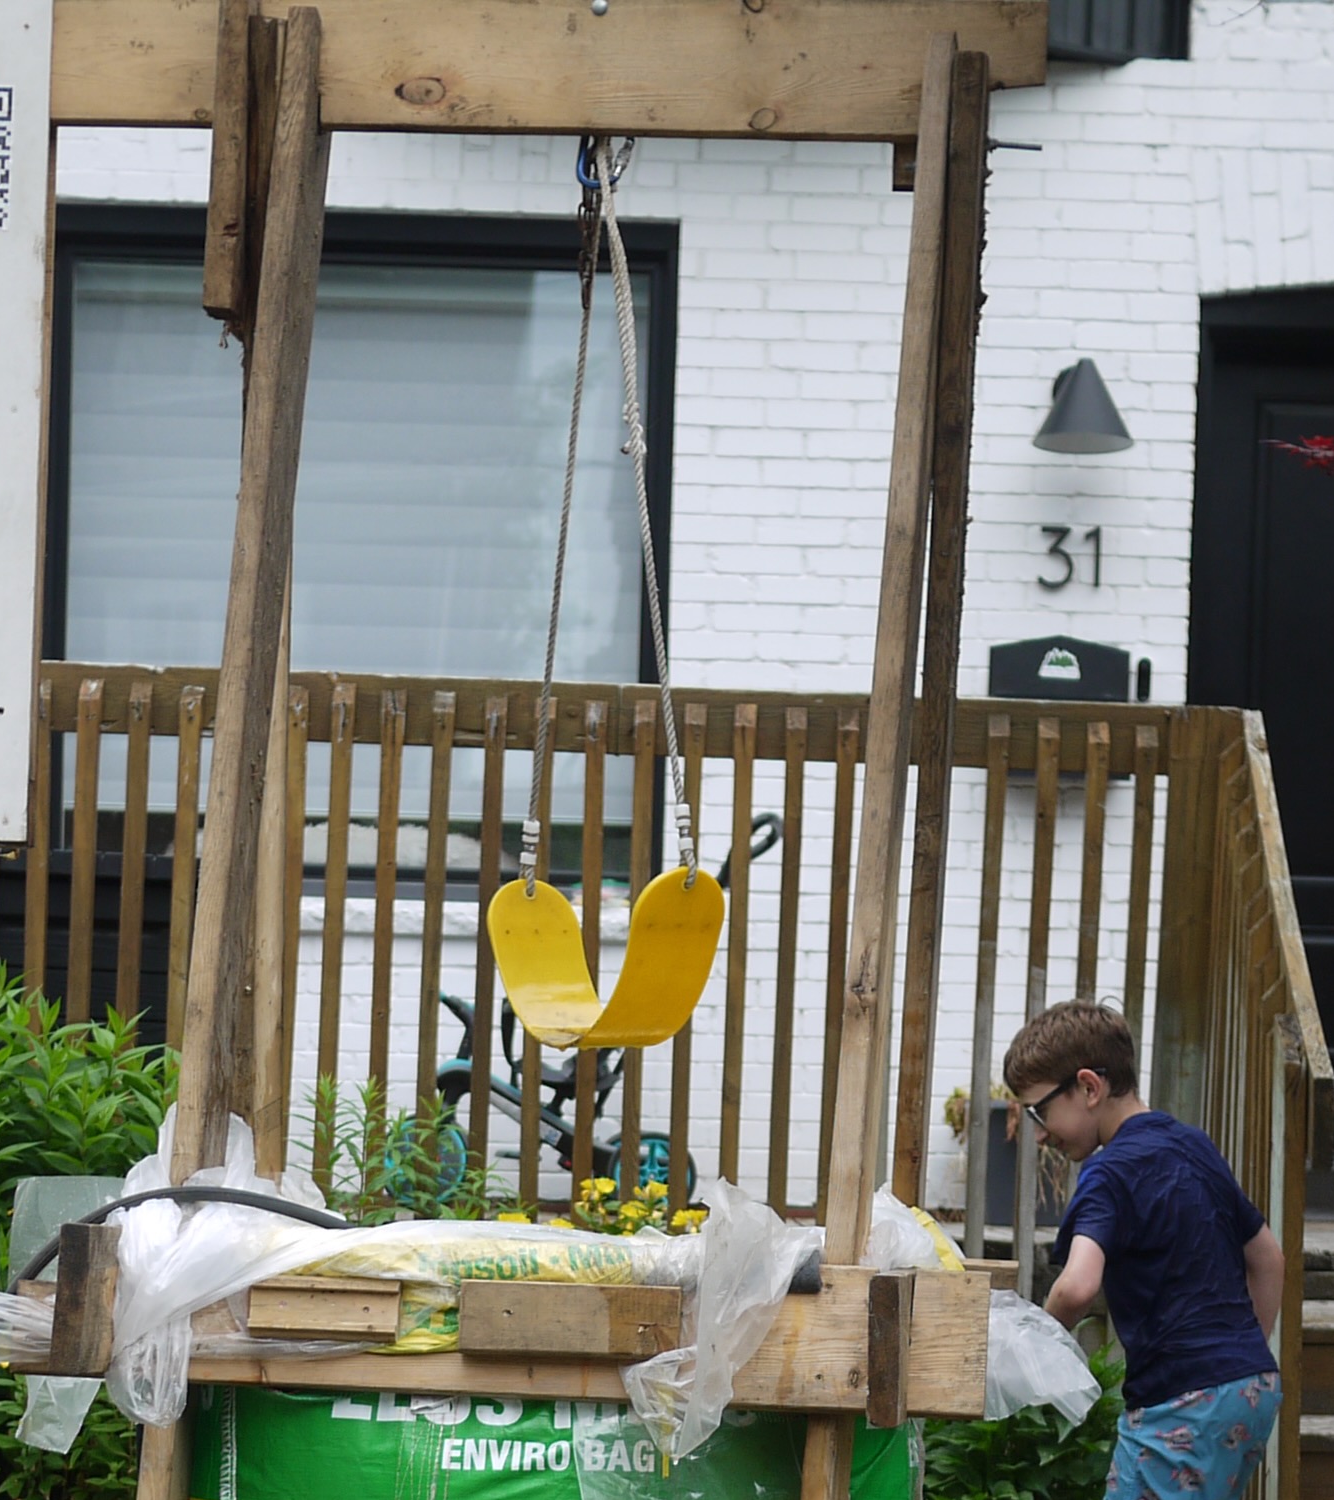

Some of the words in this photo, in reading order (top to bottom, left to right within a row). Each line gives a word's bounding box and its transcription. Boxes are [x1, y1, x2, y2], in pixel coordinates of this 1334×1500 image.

[1037, 525, 1102, 588] 31
[440, 1437, 572, 1472] ENVIRO
[582, 1440, 656, 1474] BAG
